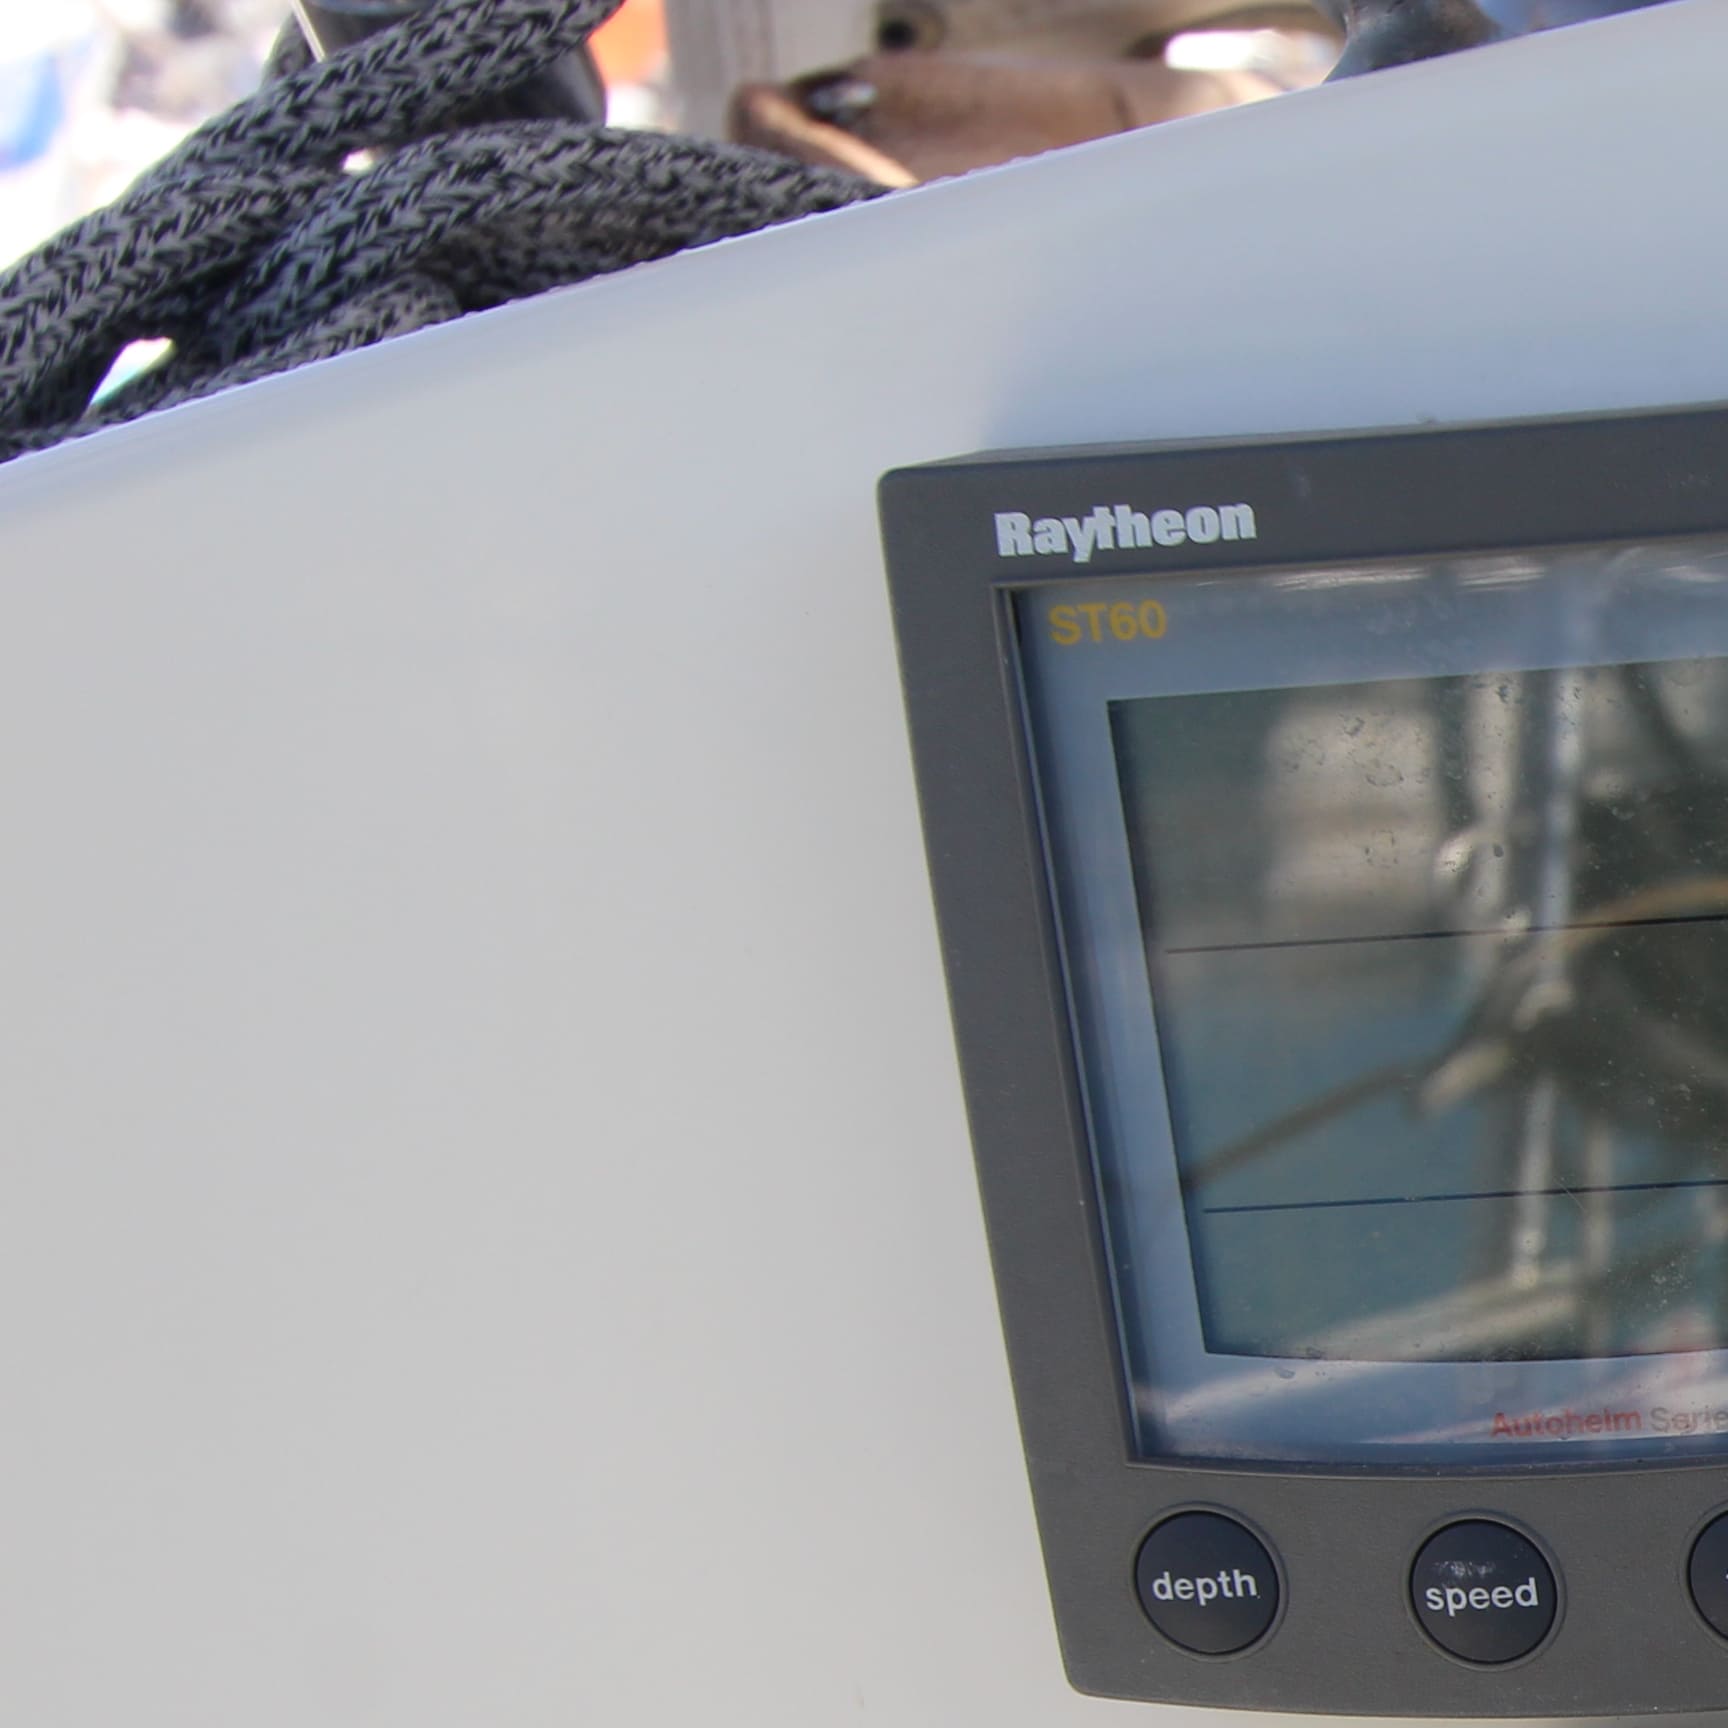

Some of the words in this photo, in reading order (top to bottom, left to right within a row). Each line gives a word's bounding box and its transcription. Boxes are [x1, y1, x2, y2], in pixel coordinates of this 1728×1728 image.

[995, 502, 1257, 562] Raytheon
[1047, 599, 1169, 647] ST60
[1150, 1566, 1258, 1606] depth
[1424, 1574, 1539, 1614] speed
